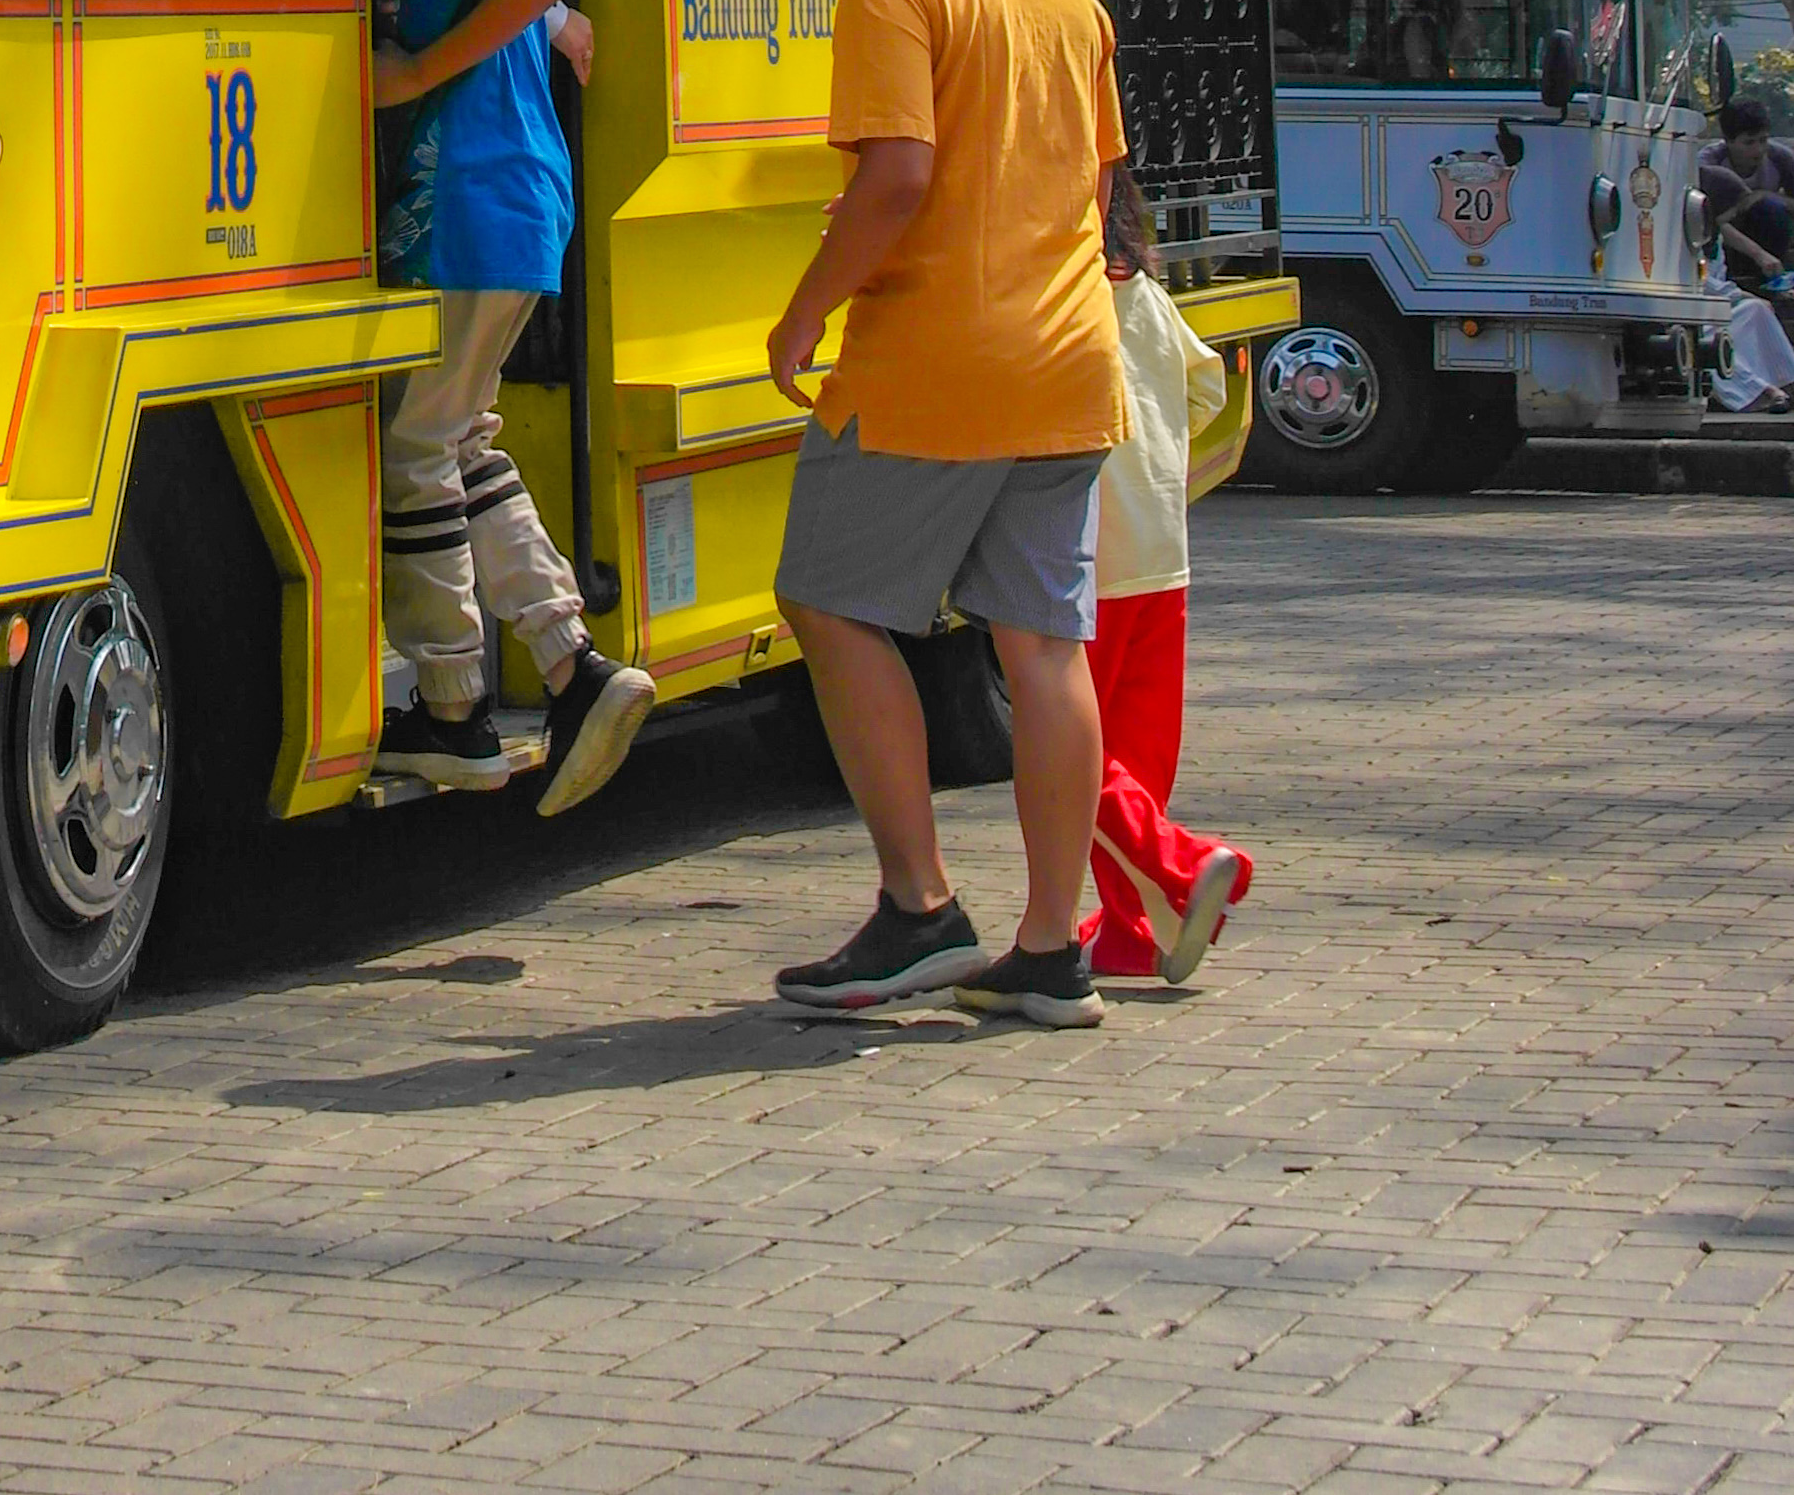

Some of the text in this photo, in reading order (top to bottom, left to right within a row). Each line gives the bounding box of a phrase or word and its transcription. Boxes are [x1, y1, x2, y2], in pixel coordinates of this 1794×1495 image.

[205, 67, 257, 214] 18
[1453, 187, 1493, 222] 20
[227, 223, 257, 260] 018A
